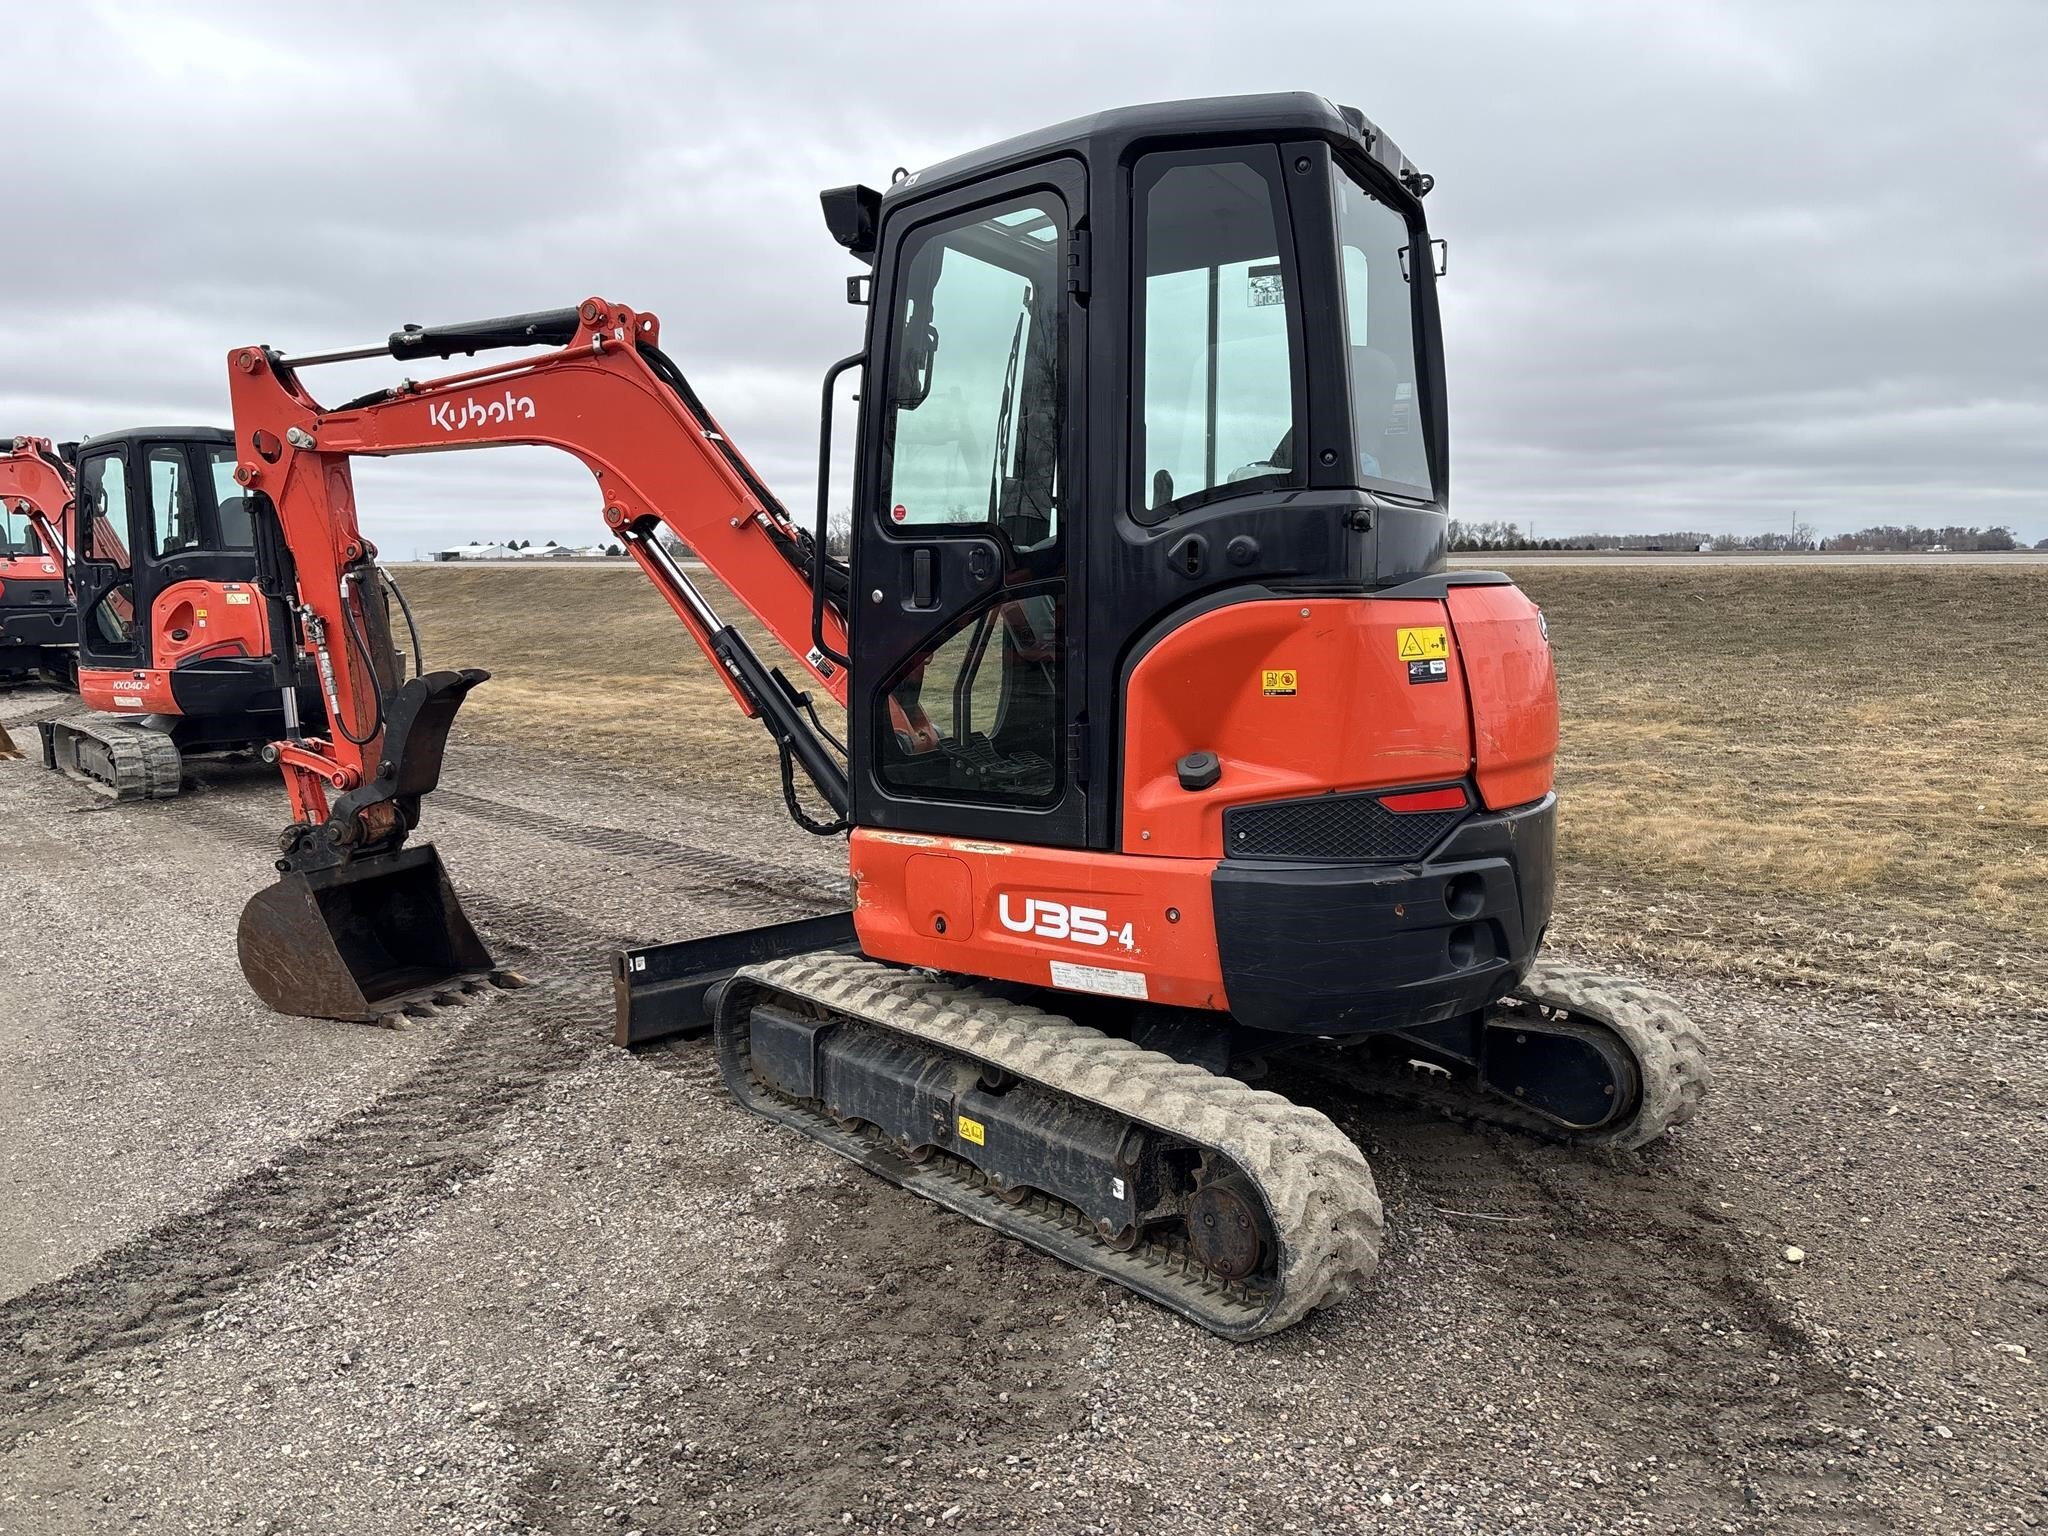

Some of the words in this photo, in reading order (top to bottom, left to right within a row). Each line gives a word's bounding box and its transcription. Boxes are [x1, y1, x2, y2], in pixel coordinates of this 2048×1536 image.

[429, 391, 535, 431] Kubota
[112, 681, 150, 690] KX040-4
[999, 893, 1134, 949] U35-4
